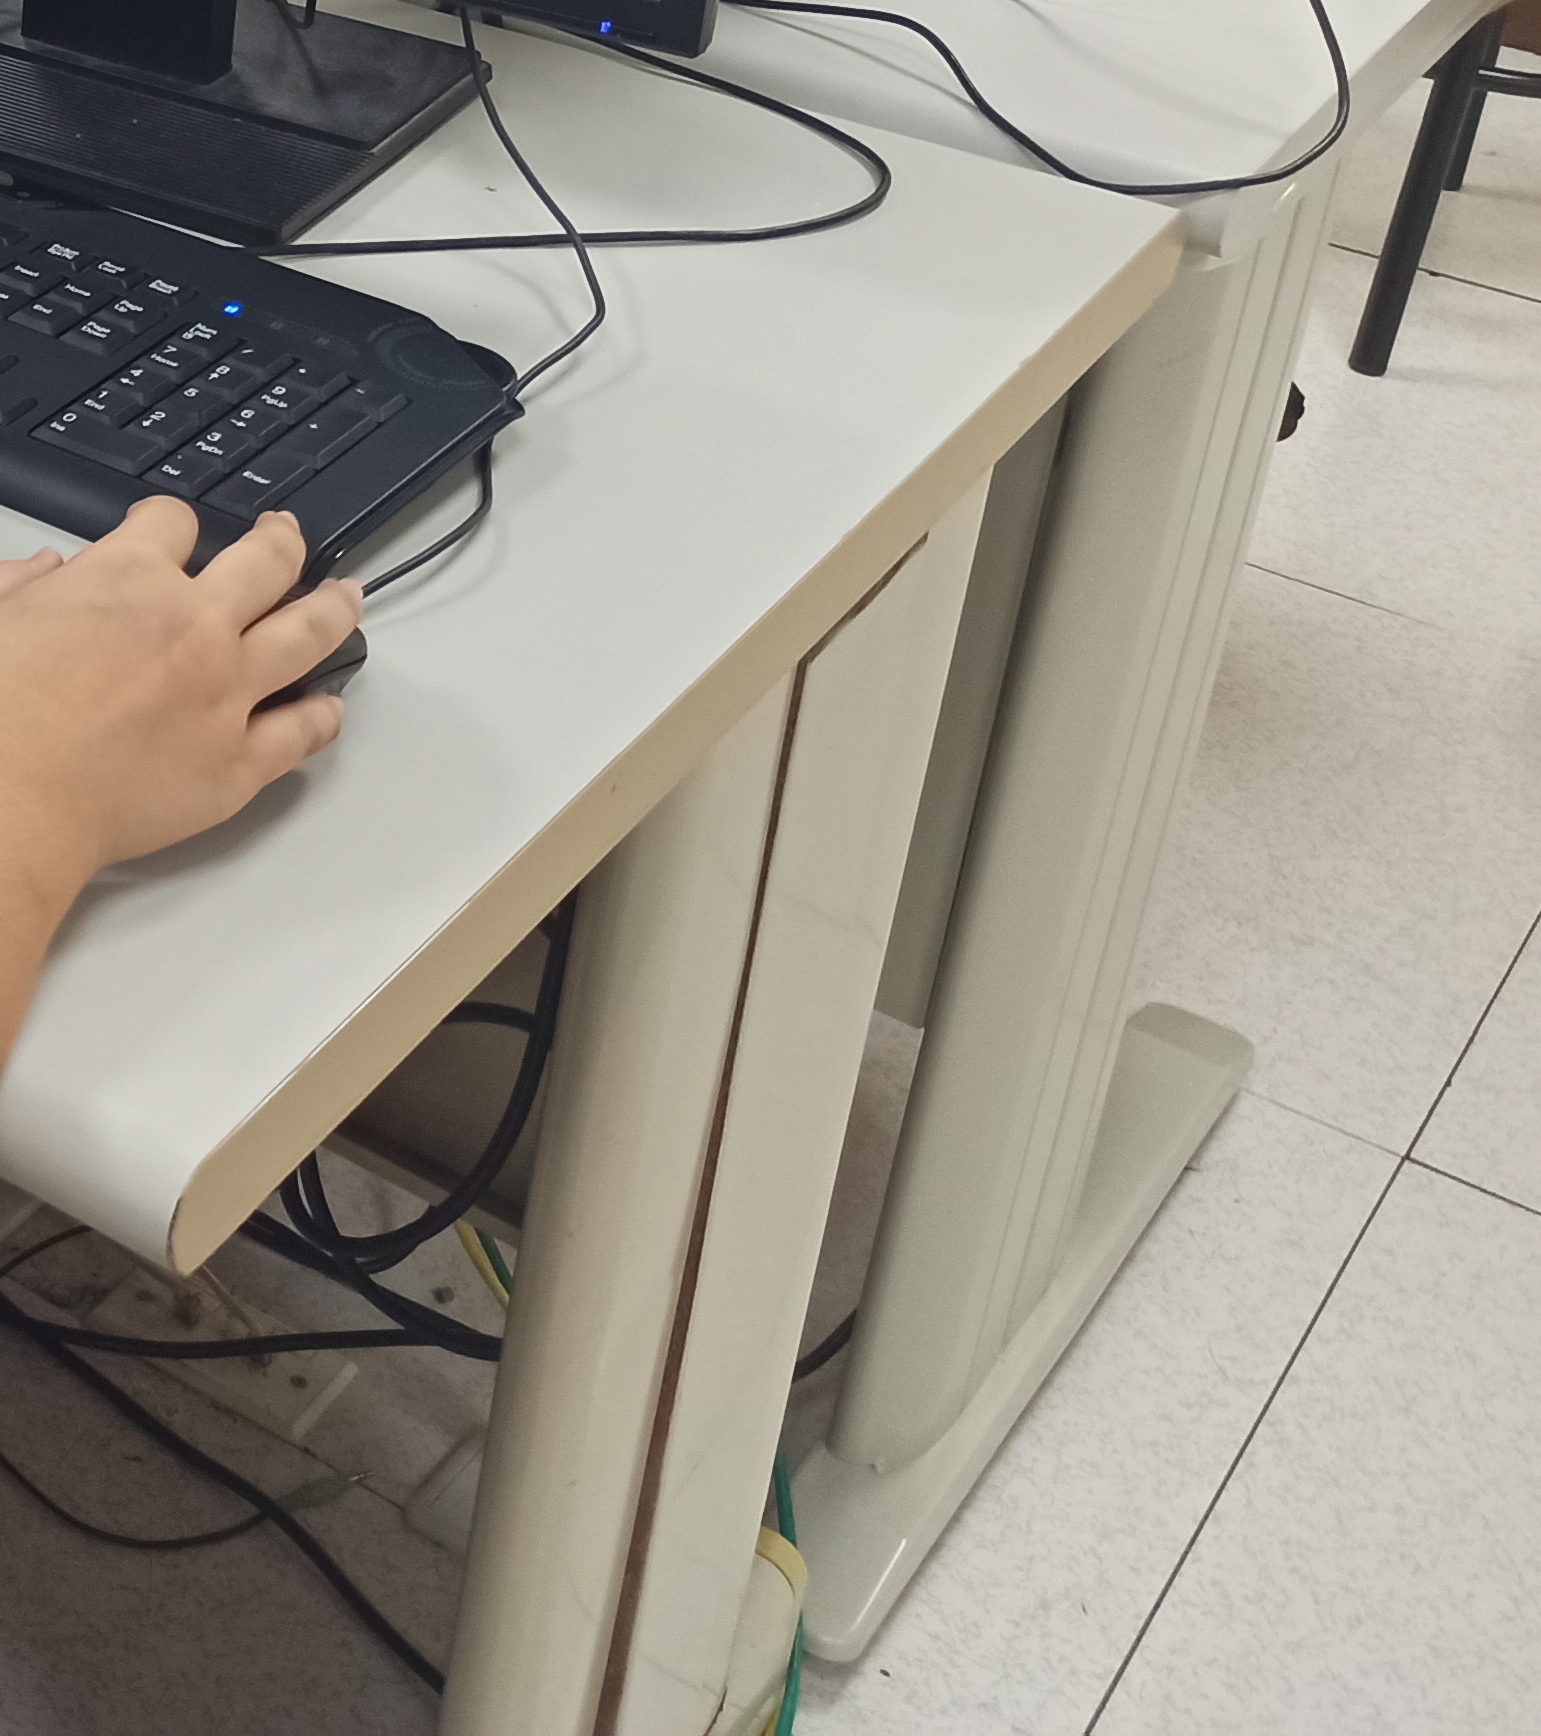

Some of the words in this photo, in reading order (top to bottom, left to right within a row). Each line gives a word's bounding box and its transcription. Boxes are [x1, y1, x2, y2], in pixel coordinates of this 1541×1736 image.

[162, 344, 178, 354] 7
[130, 369, 144, 377] 4
[215, 365, 231, 375] 8
[98, 390, 108, 399] 1
[183, 387, 199, 397] 5
[271, 385, 287, 395] 9
[62, 412, 77, 422] 0
[149, 411, 166, 421] 2
[240, 409, 255, 419] 6
[206, 431, 222, 442] 3
